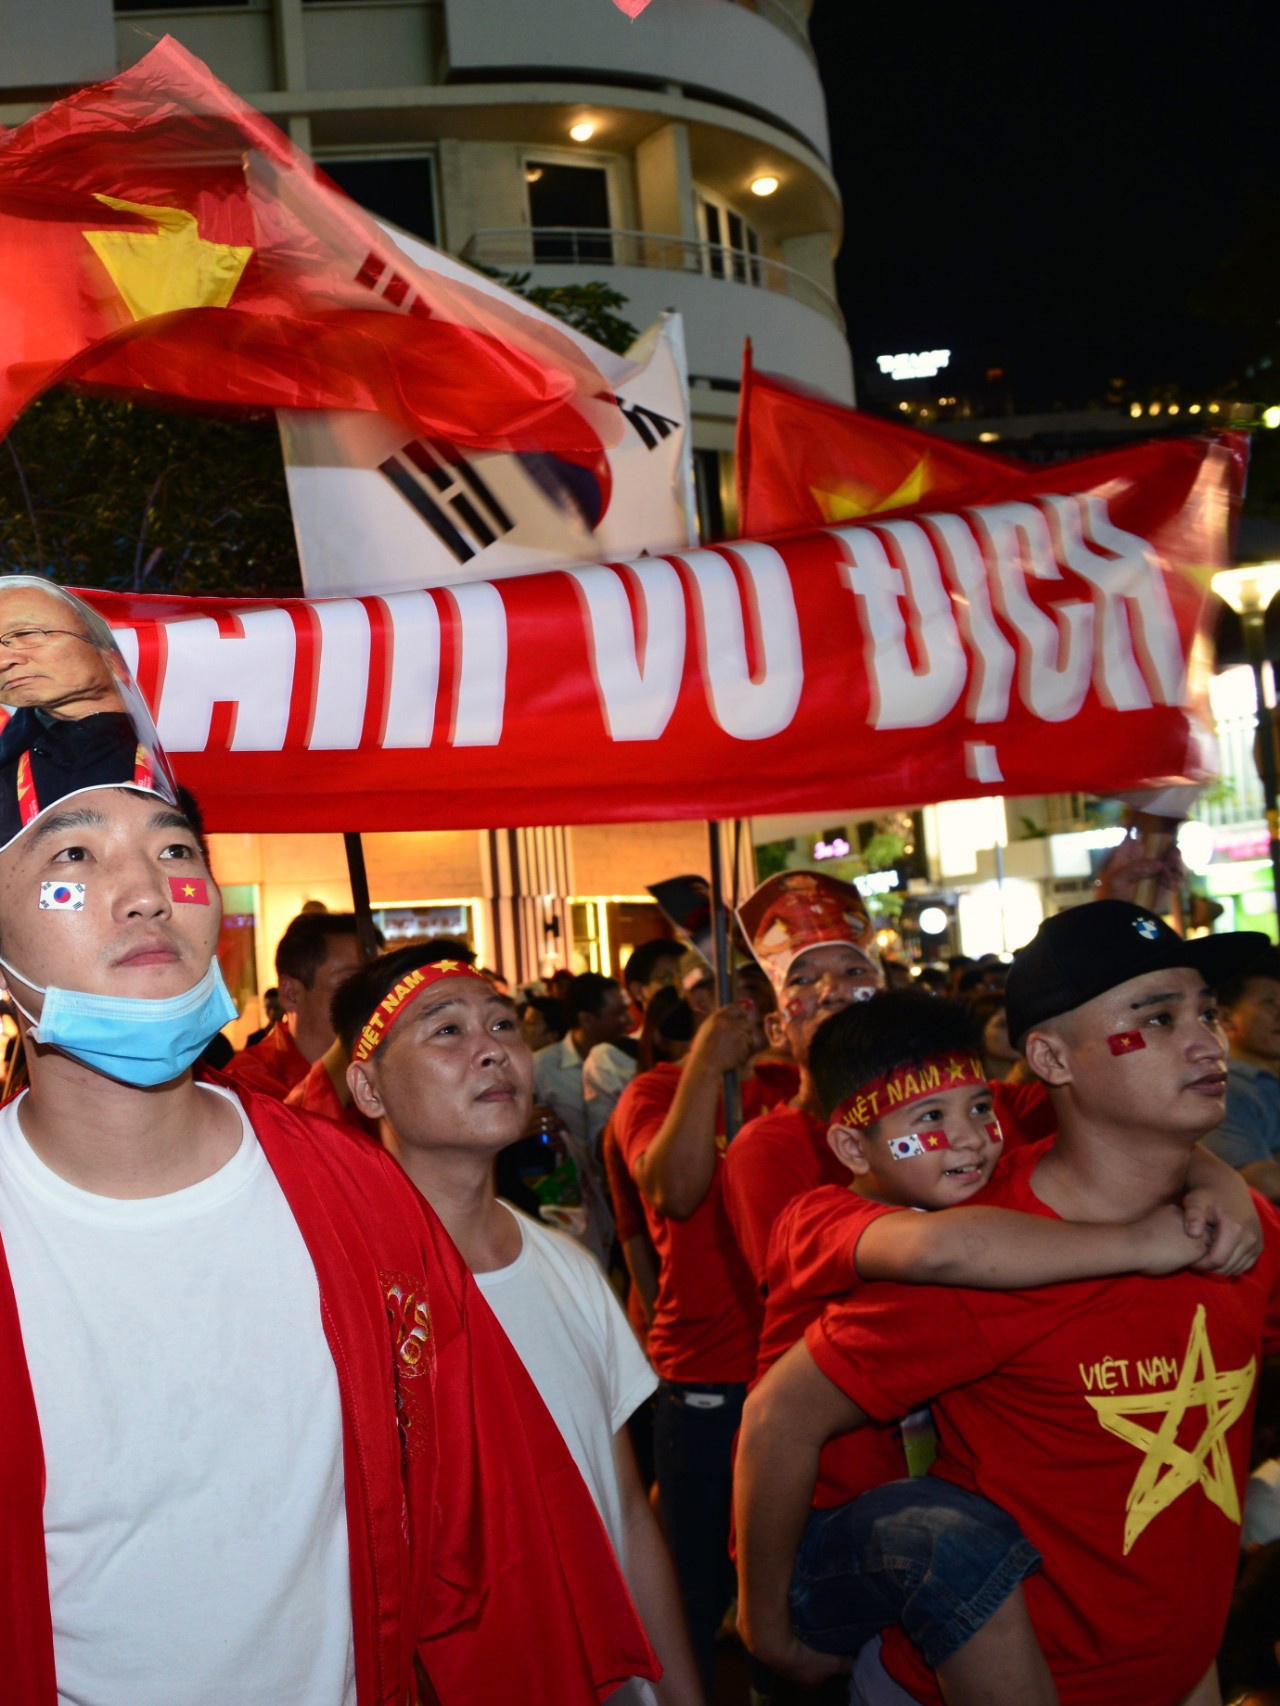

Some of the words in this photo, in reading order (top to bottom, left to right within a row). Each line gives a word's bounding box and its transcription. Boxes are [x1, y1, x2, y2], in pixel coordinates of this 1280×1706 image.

[356, 1012, 384, 1060] VIỆT
[380, 969, 425, 1014] NAM
[886, 1064, 940, 1105] NAM
[1079, 1356, 1129, 1395] VIỆT
[1136, 1355, 1178, 1388] NAM
